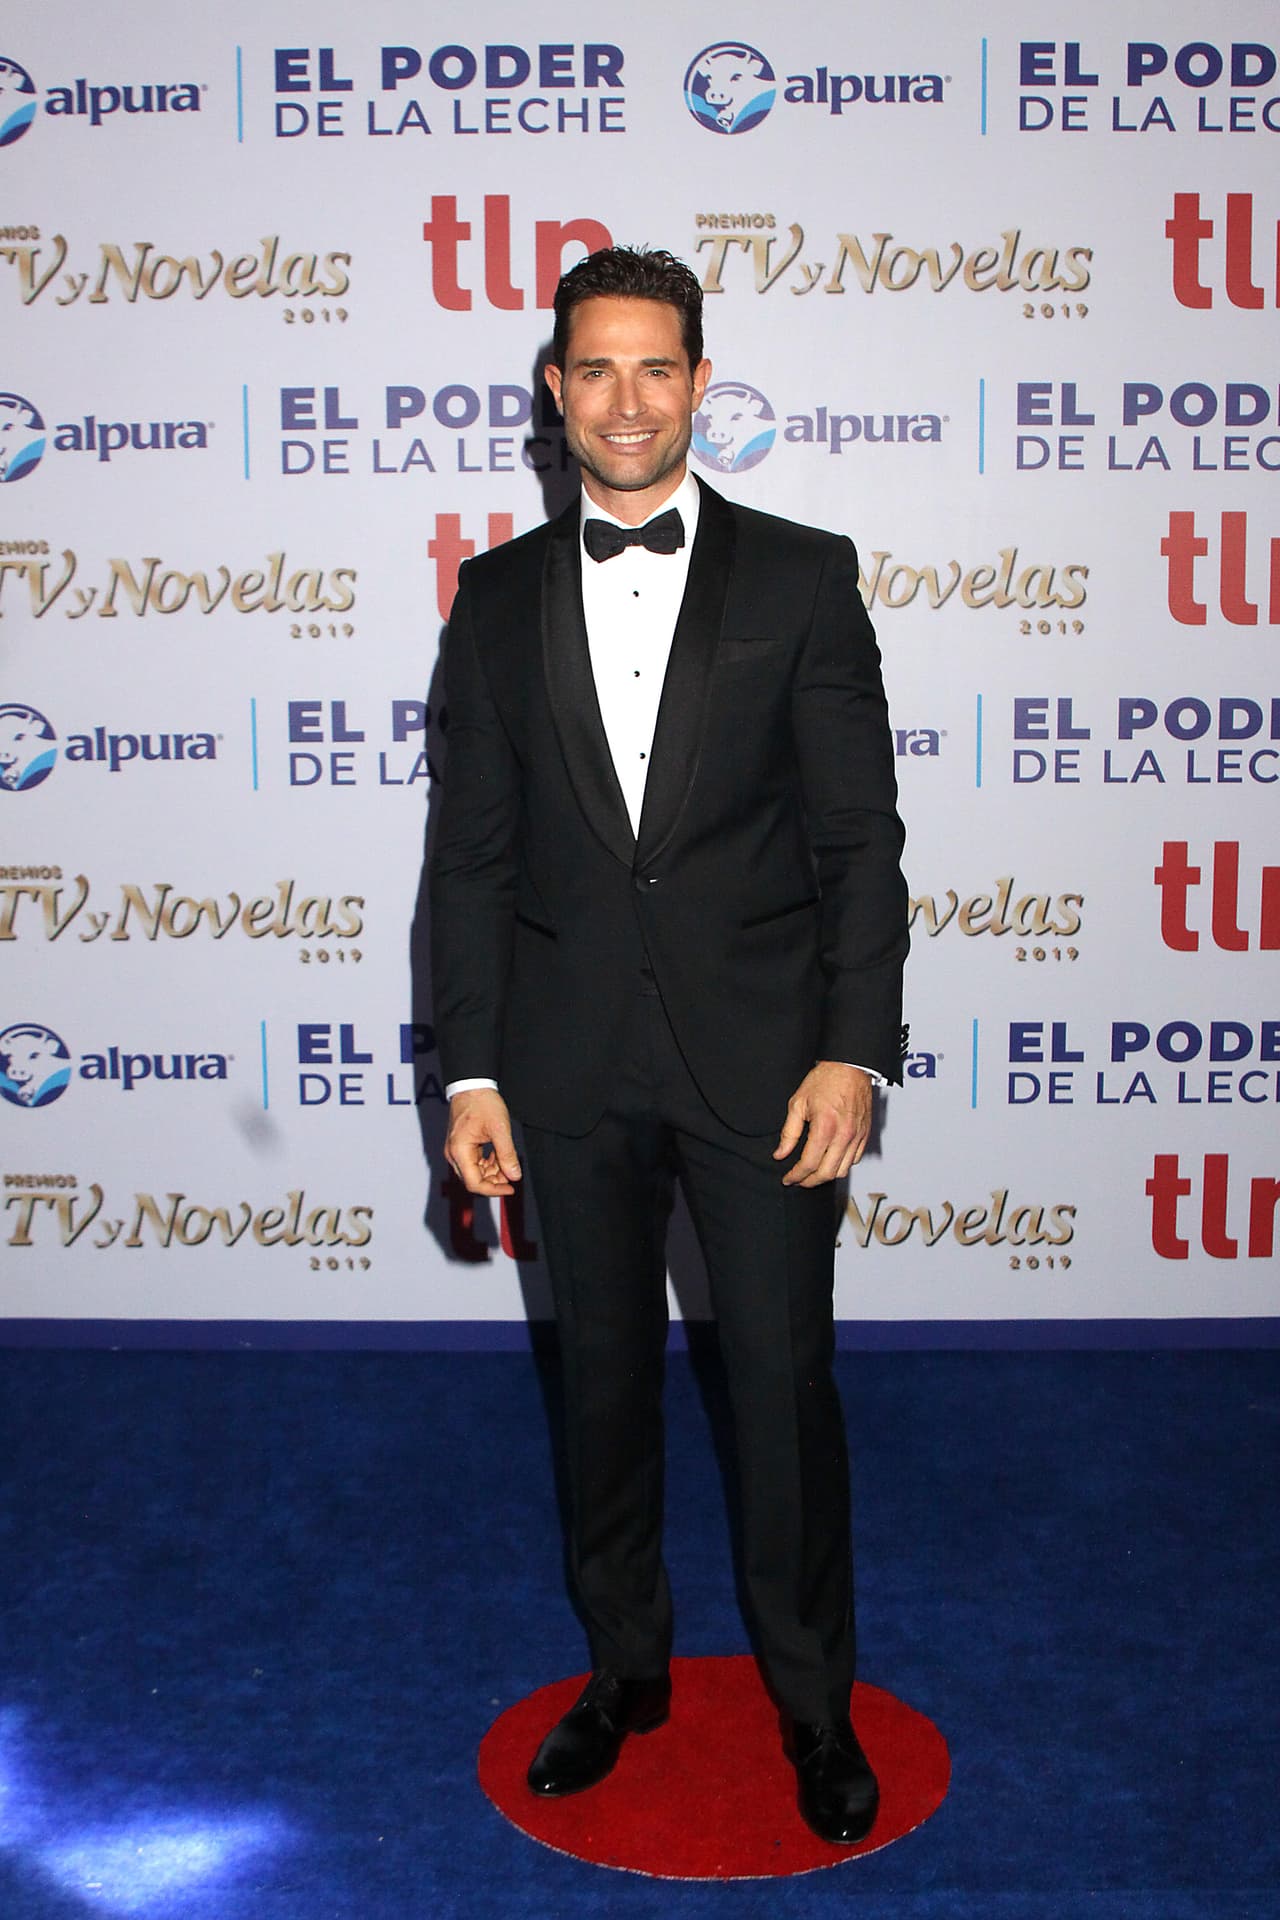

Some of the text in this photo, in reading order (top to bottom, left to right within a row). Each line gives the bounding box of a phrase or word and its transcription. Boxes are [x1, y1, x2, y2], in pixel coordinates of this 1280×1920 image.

[274, 44, 624, 93] EL PODER
[1020, 42, 1099, 86] EL
[44, 78, 200, 126] alpura
[784, 66, 944, 115] alpura
[275, 97, 626, 137] DE LA LECHE
[1020, 96, 1088, 131] DE
[1112, 96, 1176, 132] LA
[695, 213, 776, 229] PREMIOS
[1165, 193, 1280, 310] tl
[284, 308, 348, 324] 2019
[1023, 304, 1088, 319] 2019
[280, 387, 358, 430] EL
[1017, 383, 1095, 425] EL
[53, 415, 208, 462] alpura
[784, 407, 942, 454] alpura
[281, 440, 349, 474] DE
[373, 438, 436, 473] LA
[1017, 436, 1084, 470] DE
[1108, 436, 1171, 470] LA
[1161, 511, 1280, 626] tl
[291, 624, 354, 639] 2019
[1020, 620, 1084, 635] 2019
[288, 701, 365, 743] EL
[1014, 698, 1090, 740] EL
[64, 726, 216, 772] alpura
[289, 752, 441, 786] DE LA
[1013, 749, 1080, 783] DE
[1104, 750, 1166, 783] LA
[1154, 841, 1280, 952] tl
[300, 949, 362, 963] 2019
[1016, 947, 1079, 962] 2019
[297, 1024, 373, 1064] EL
[1009, 1022, 1084, 1063] EL
[79, 1046, 227, 1091] alpura
[1008, 1072, 1073, 1104] DE
[1097, 1072, 1157, 1104] LA
[299, 1073, 447, 1105] DE LA
[4, 1174, 78, 1188] PREMIOS
[310, 1257, 371, 1271] 2019
[1010, 1255, 1072, 1270] 2019
